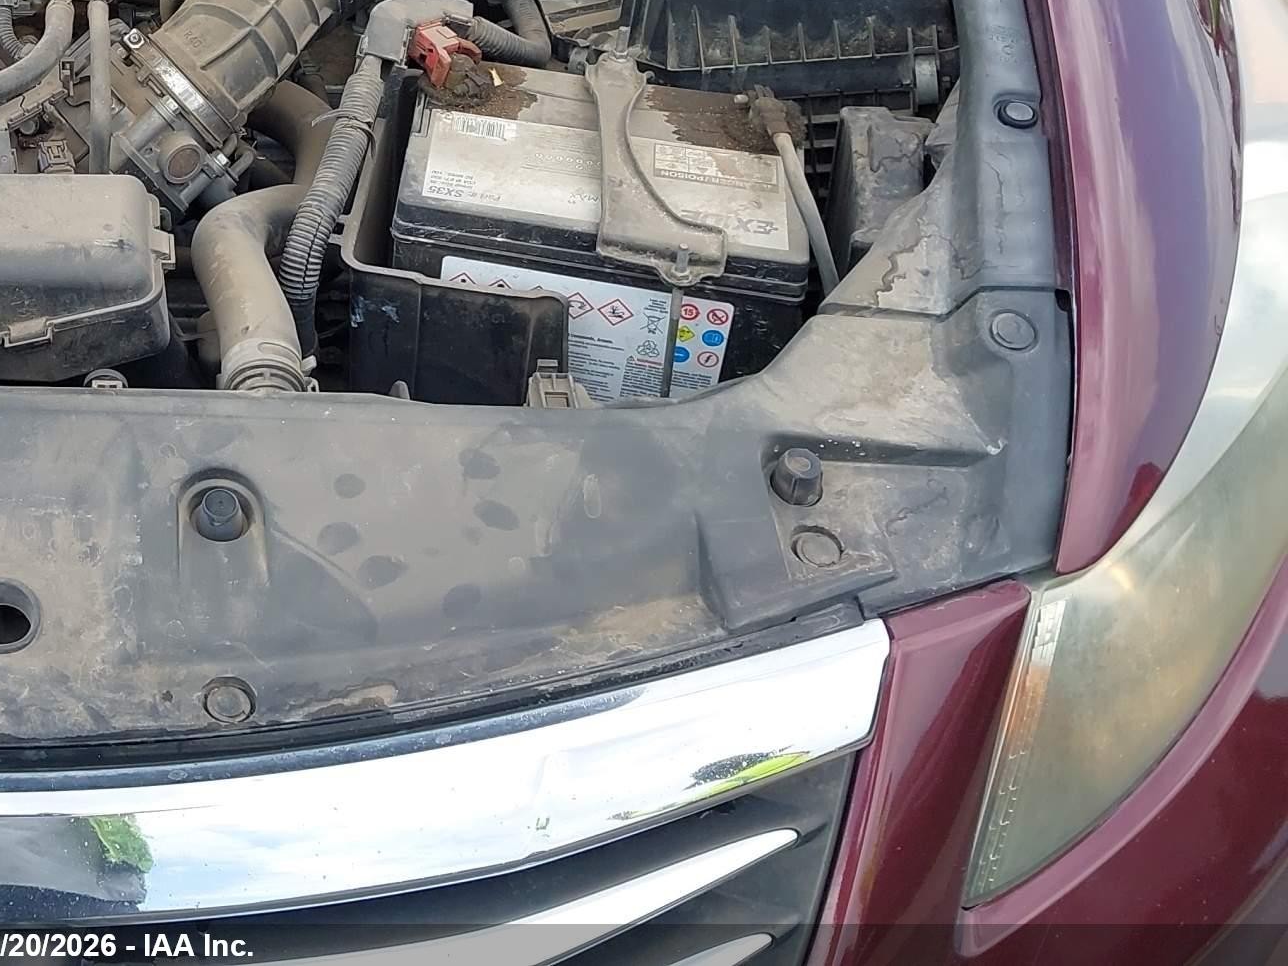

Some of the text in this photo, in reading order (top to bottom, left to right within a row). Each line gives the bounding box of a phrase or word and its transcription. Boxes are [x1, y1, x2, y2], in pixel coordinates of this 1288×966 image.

[427, 185, 465, 199] SX35
[679, 209, 779, 235] EXIDE
[683, 308, 694, 316] 15
